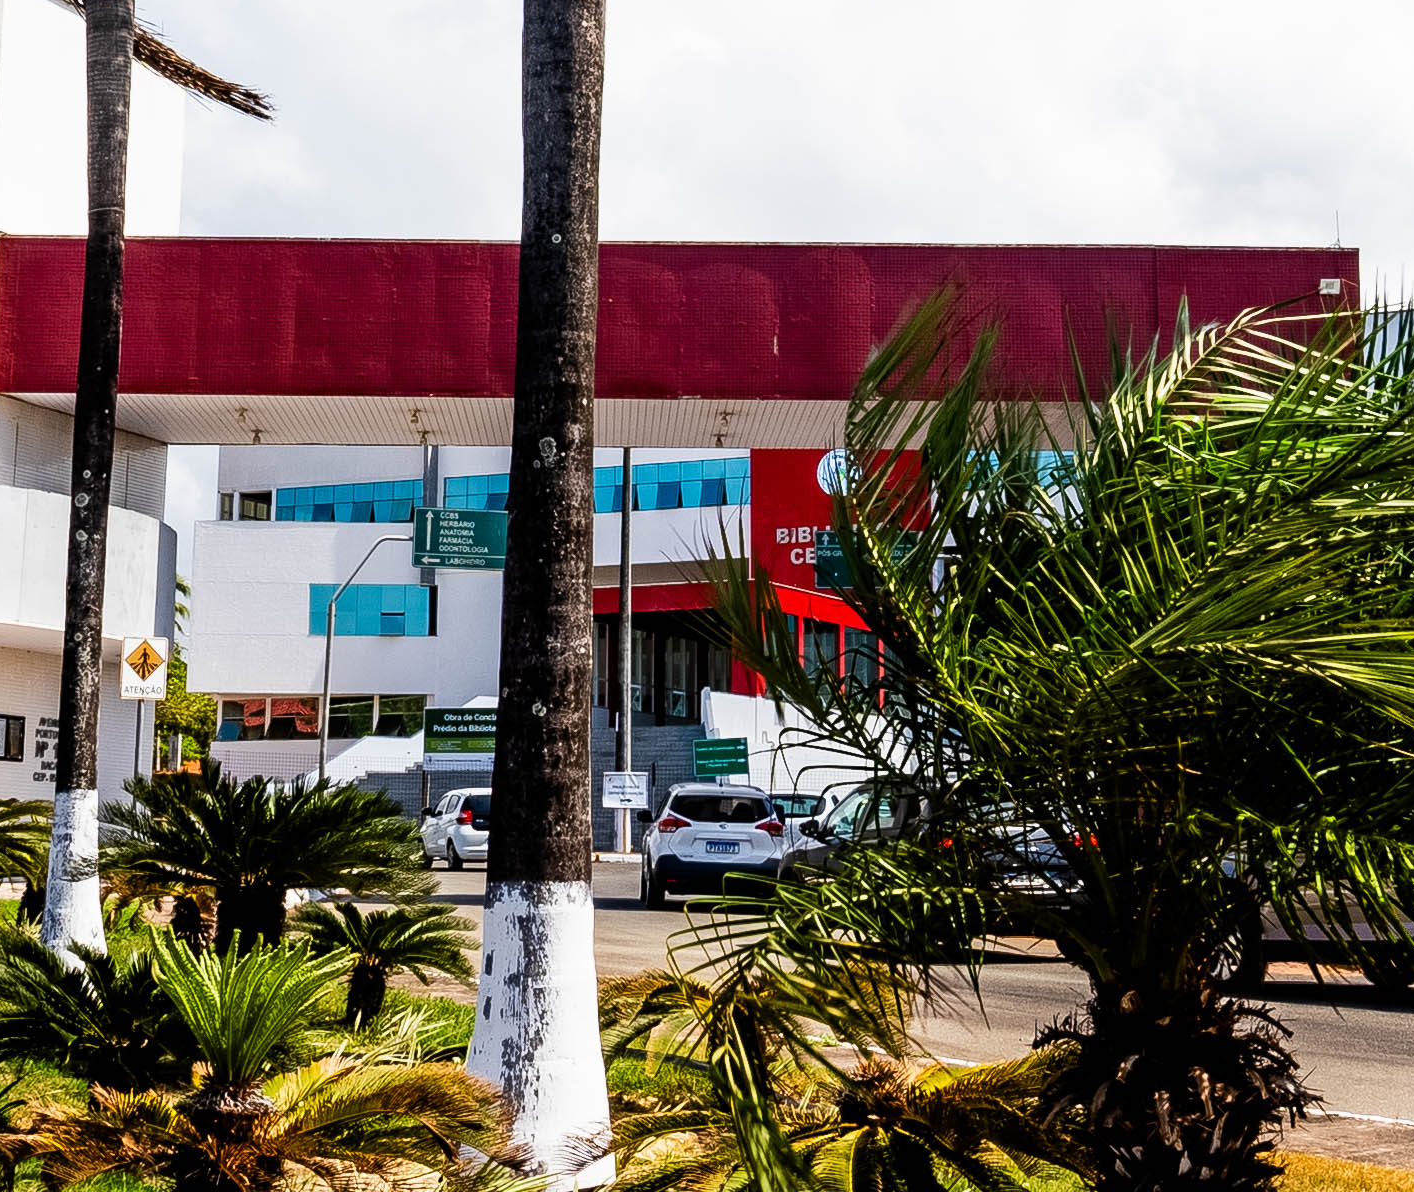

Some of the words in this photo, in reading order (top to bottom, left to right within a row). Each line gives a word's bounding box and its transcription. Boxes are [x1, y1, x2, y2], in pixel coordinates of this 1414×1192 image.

[439, 528, 475, 537] ANATOMIA
[438, 545, 489, 554] ODONTOLOGIA
[123, 685, 163, 696] ATENÇÃO
[443, 713, 462, 721] Obra
[463, 713, 472, 721] de
[458, 724, 467, 732] da
